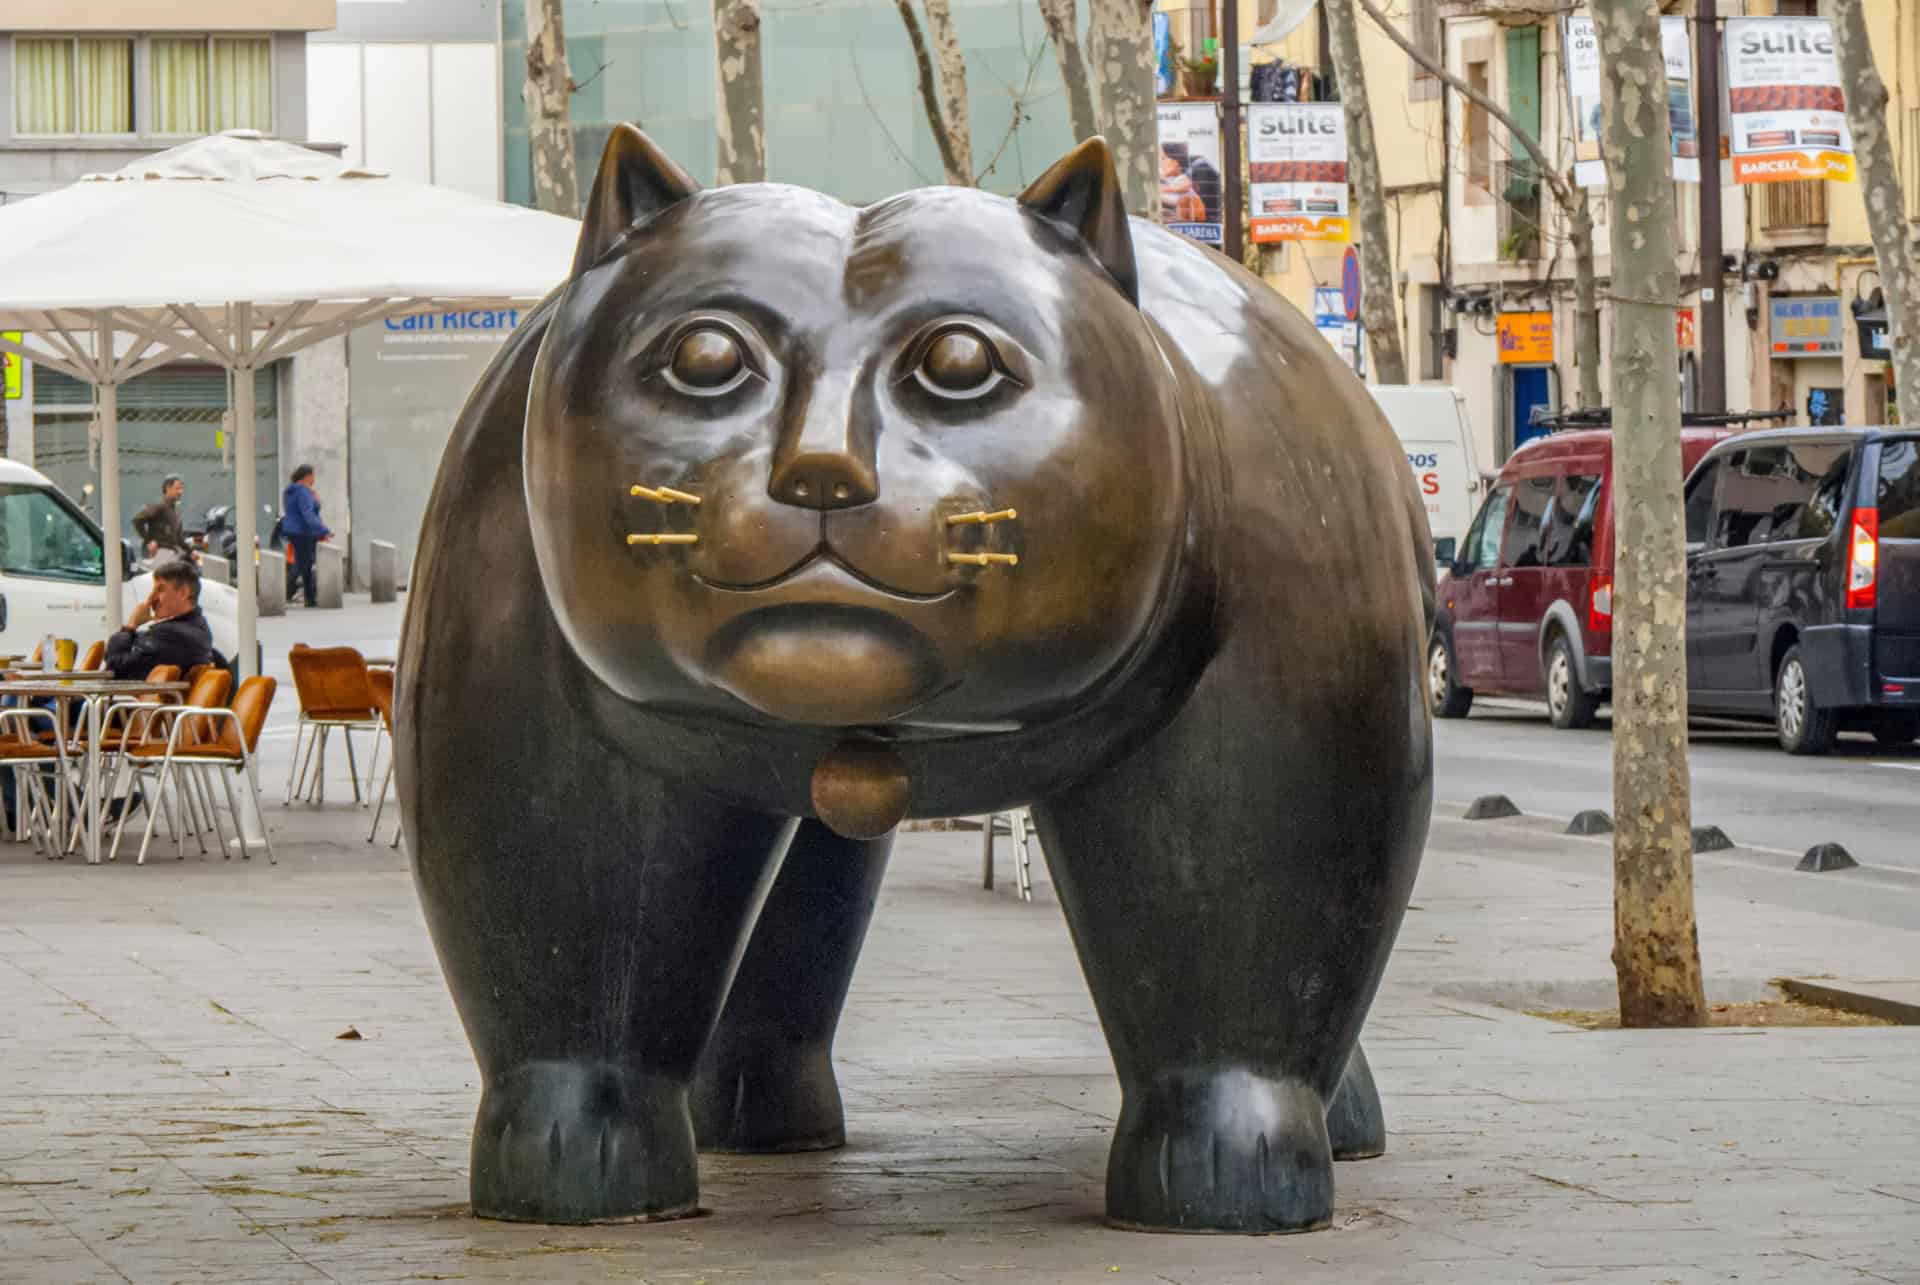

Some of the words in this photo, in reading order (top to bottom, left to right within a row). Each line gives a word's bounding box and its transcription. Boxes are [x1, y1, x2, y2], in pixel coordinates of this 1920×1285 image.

[1740, 25, 1833, 54] suite
[1260, 110, 1337, 135] suite
[443, 308, 518, 329] Ricart
